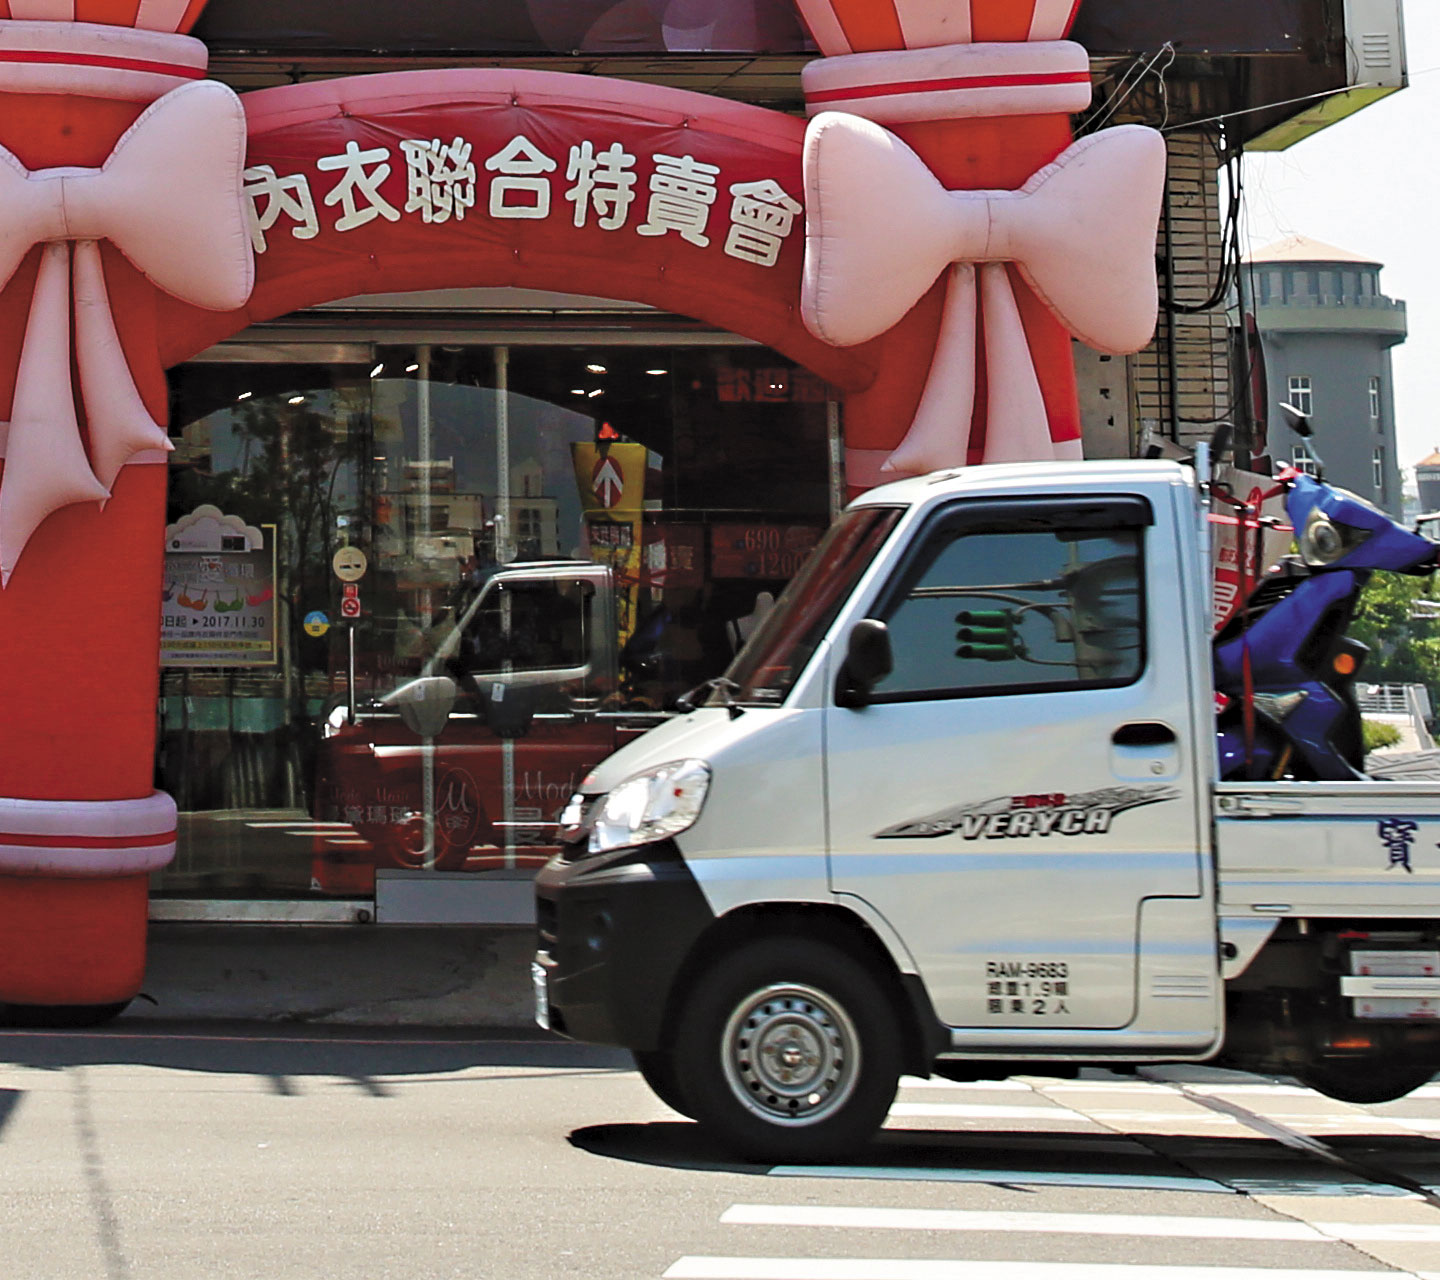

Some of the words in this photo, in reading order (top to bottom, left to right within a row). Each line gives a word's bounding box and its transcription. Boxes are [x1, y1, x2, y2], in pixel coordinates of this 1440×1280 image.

[242, 134, 803, 268] 內衣聯合特賣會
[202, 615, 265, 628] 2017.11.30
[962, 808, 1113, 840] VERYCA
